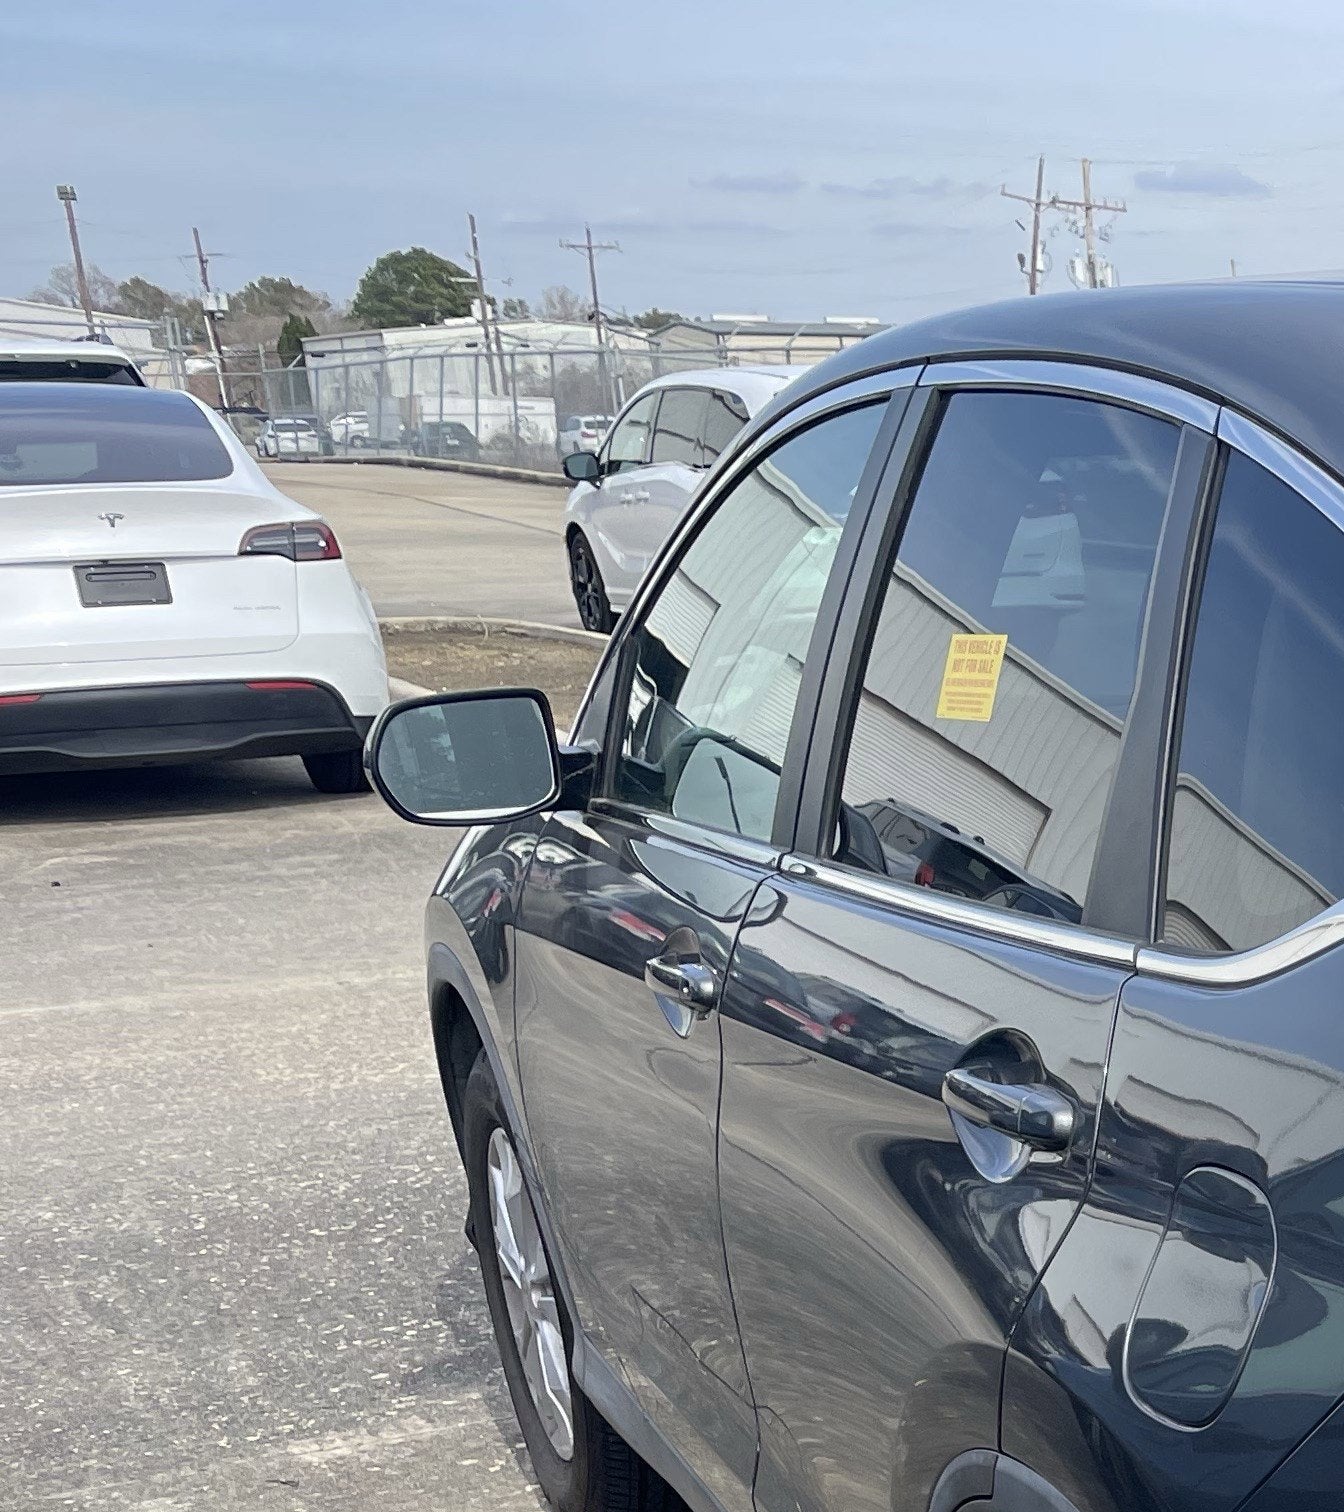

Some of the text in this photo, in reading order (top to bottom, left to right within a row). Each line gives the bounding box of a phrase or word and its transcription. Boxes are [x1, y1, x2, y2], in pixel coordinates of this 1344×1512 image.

[954, 640, 1002, 655] THIS VEHICLE IS
[952, 658, 995, 673] NOT FOR SALE
